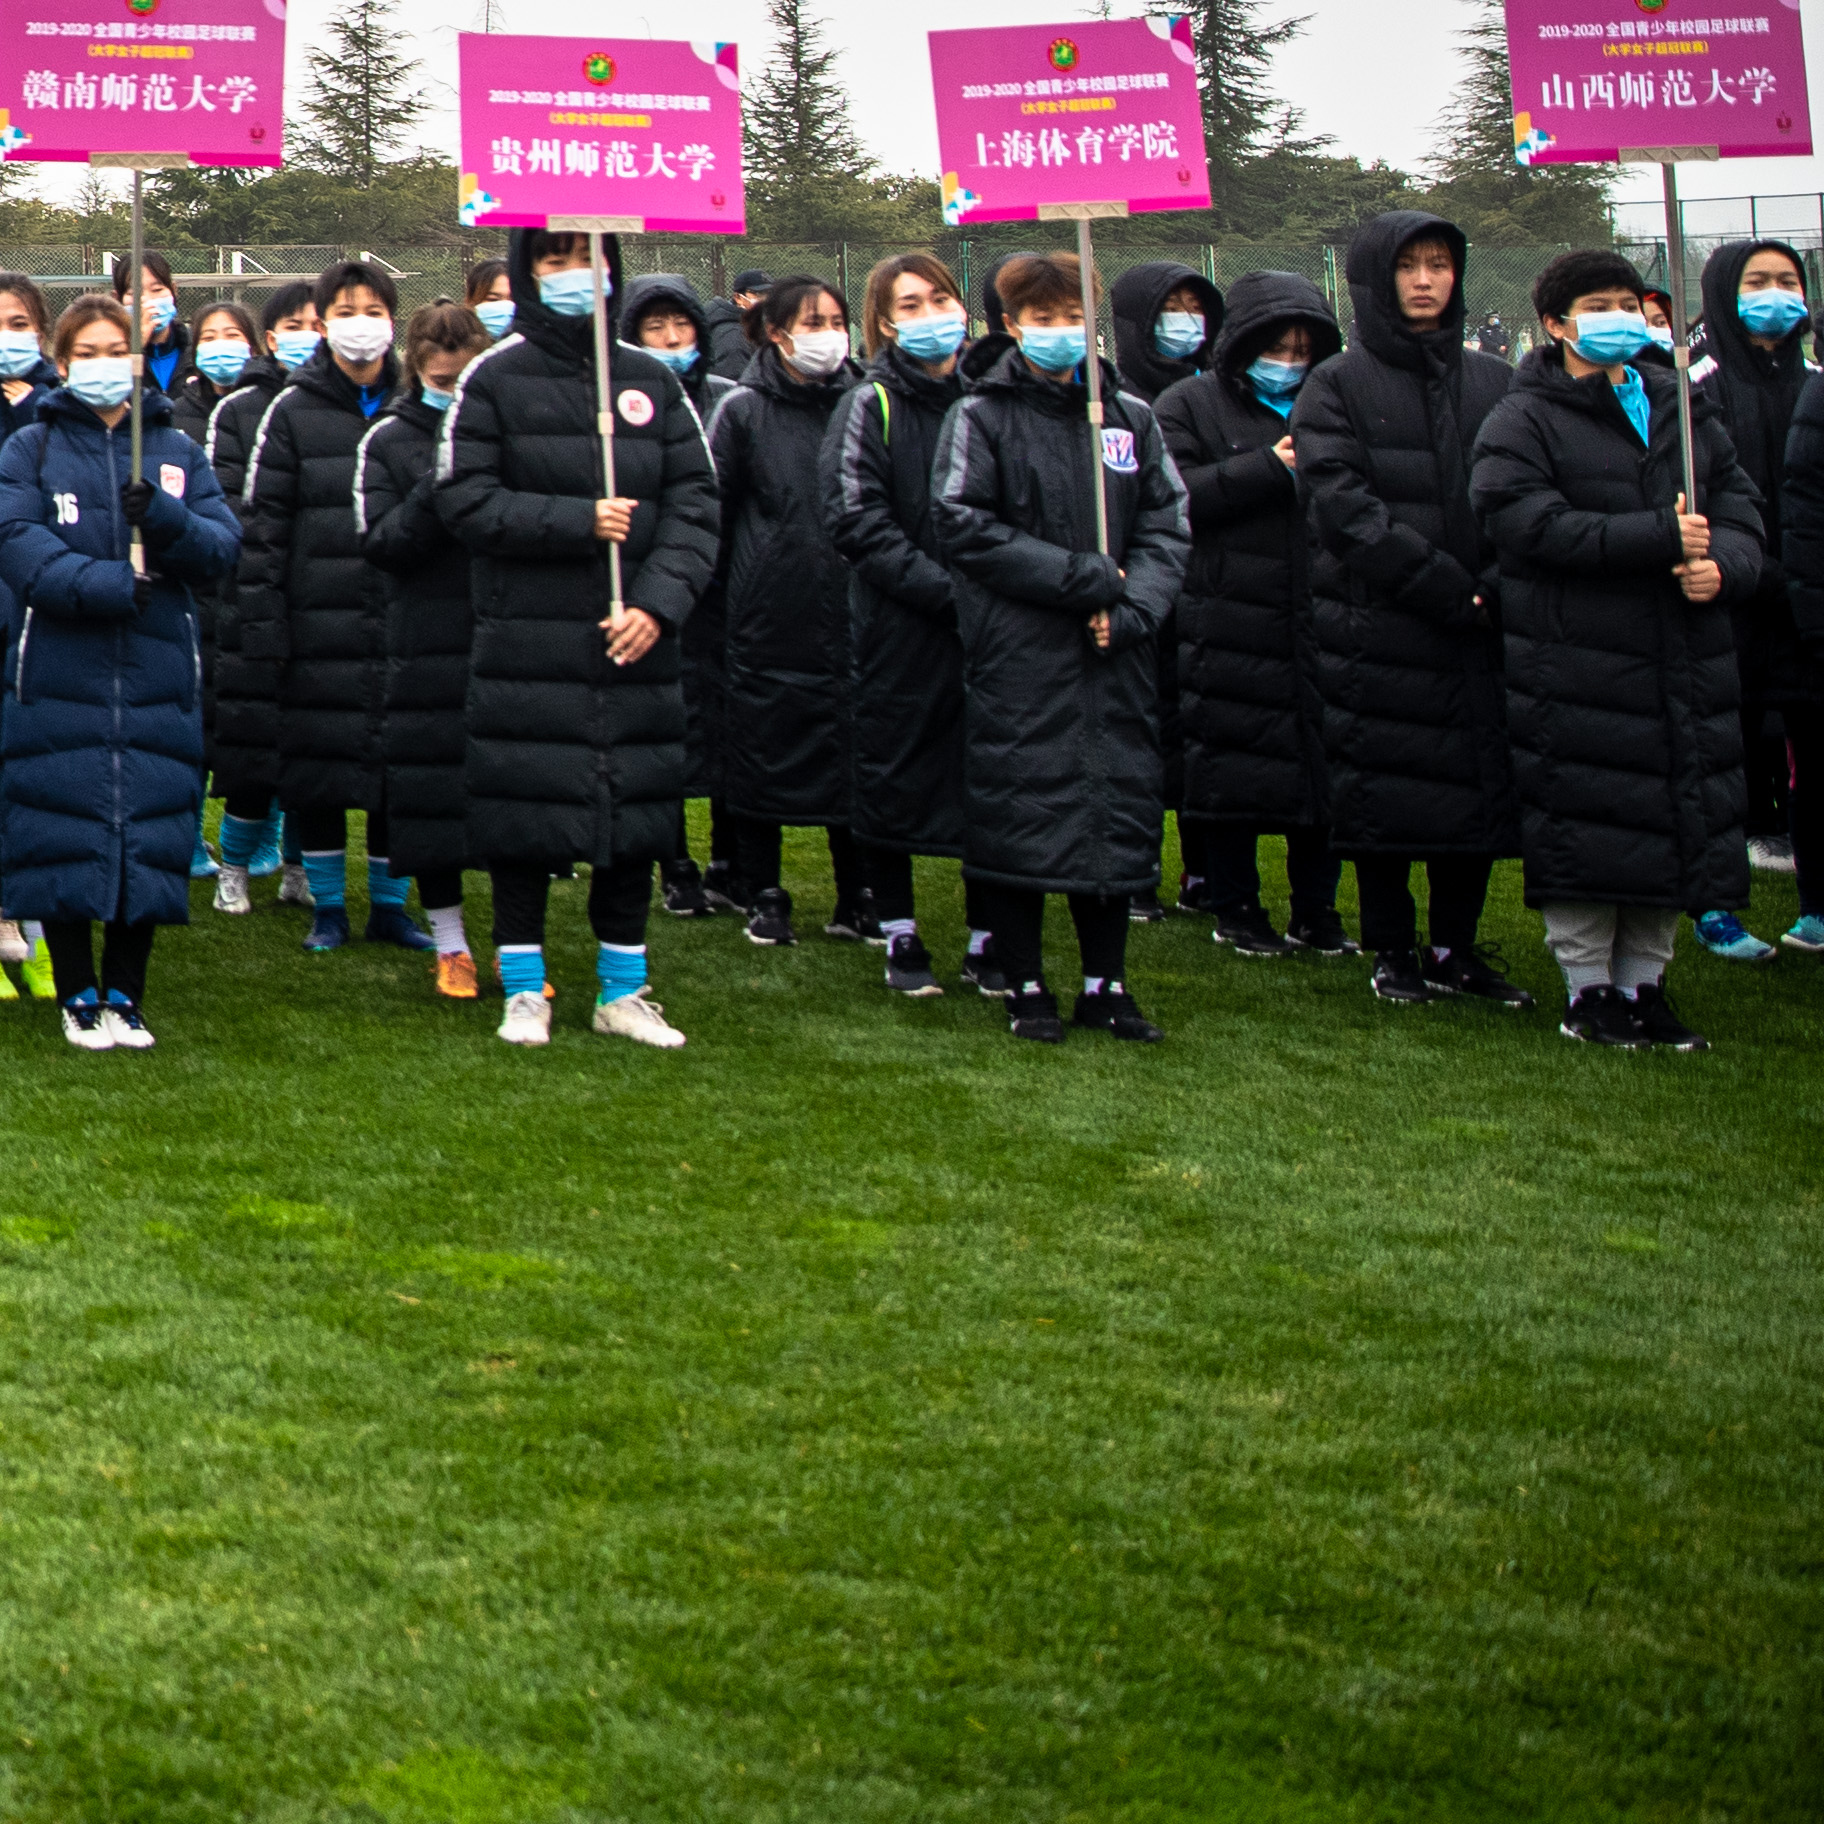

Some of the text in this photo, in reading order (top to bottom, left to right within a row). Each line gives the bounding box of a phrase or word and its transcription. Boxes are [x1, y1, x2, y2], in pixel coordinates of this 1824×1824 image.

[1538, 17, 1769, 38] 2019-2020 全国青少年校园足球联赛
[23, 70, 258, 113] 赣南师范大学
[1542, 67, 1776, 110] 山西师范大学
[489, 136, 716, 181] 贵州师范大学
[968, 120, 1180, 167] 上海体育学院
[53, 492, 79, 525] 16
